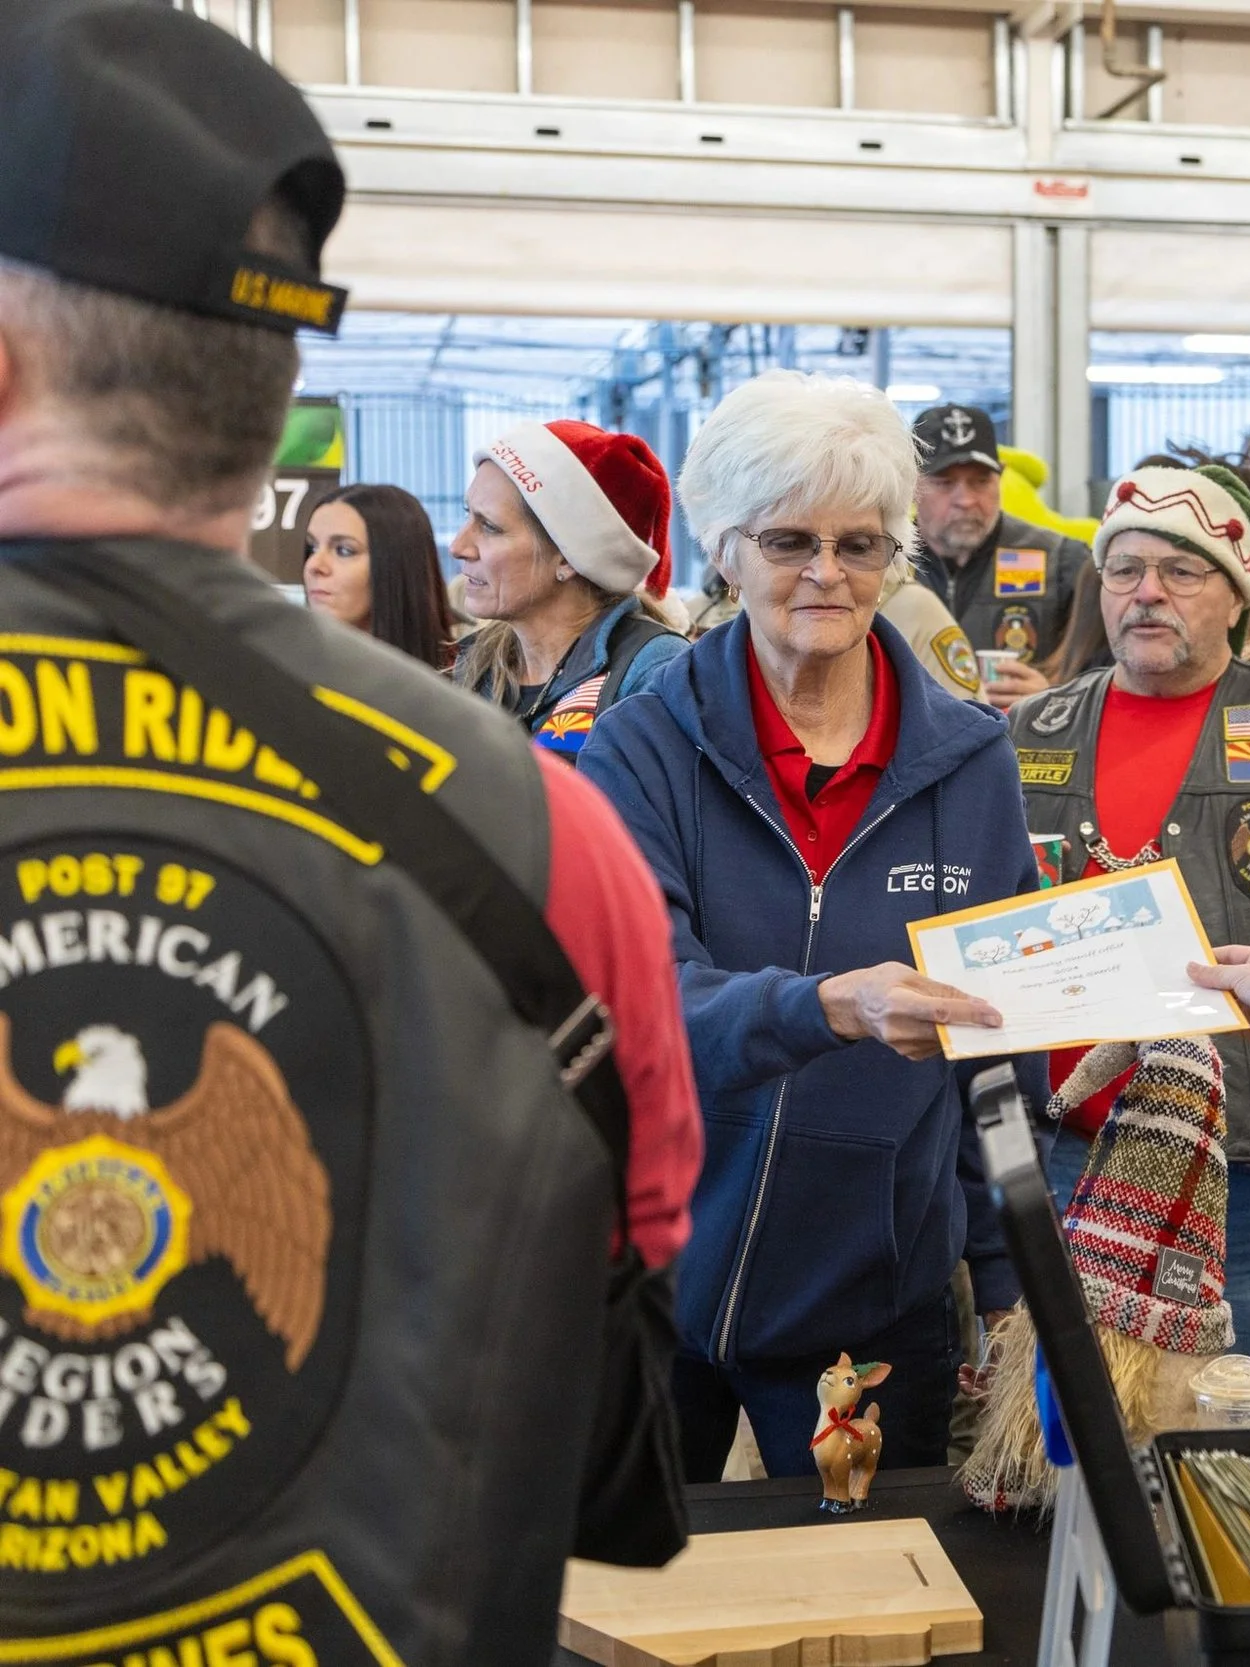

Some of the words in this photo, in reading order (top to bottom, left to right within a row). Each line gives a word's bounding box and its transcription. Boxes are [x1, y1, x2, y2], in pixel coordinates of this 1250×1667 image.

[1020, 769, 1063, 781] URTLE
[17, 853, 144, 904] POST
[915, 863, 972, 877] AMRICAN
[887, 874, 969, 895] LEGON
[1167, 1259, 1194, 1282] Merry
[93, 1395, 252, 1516] VALLEY
